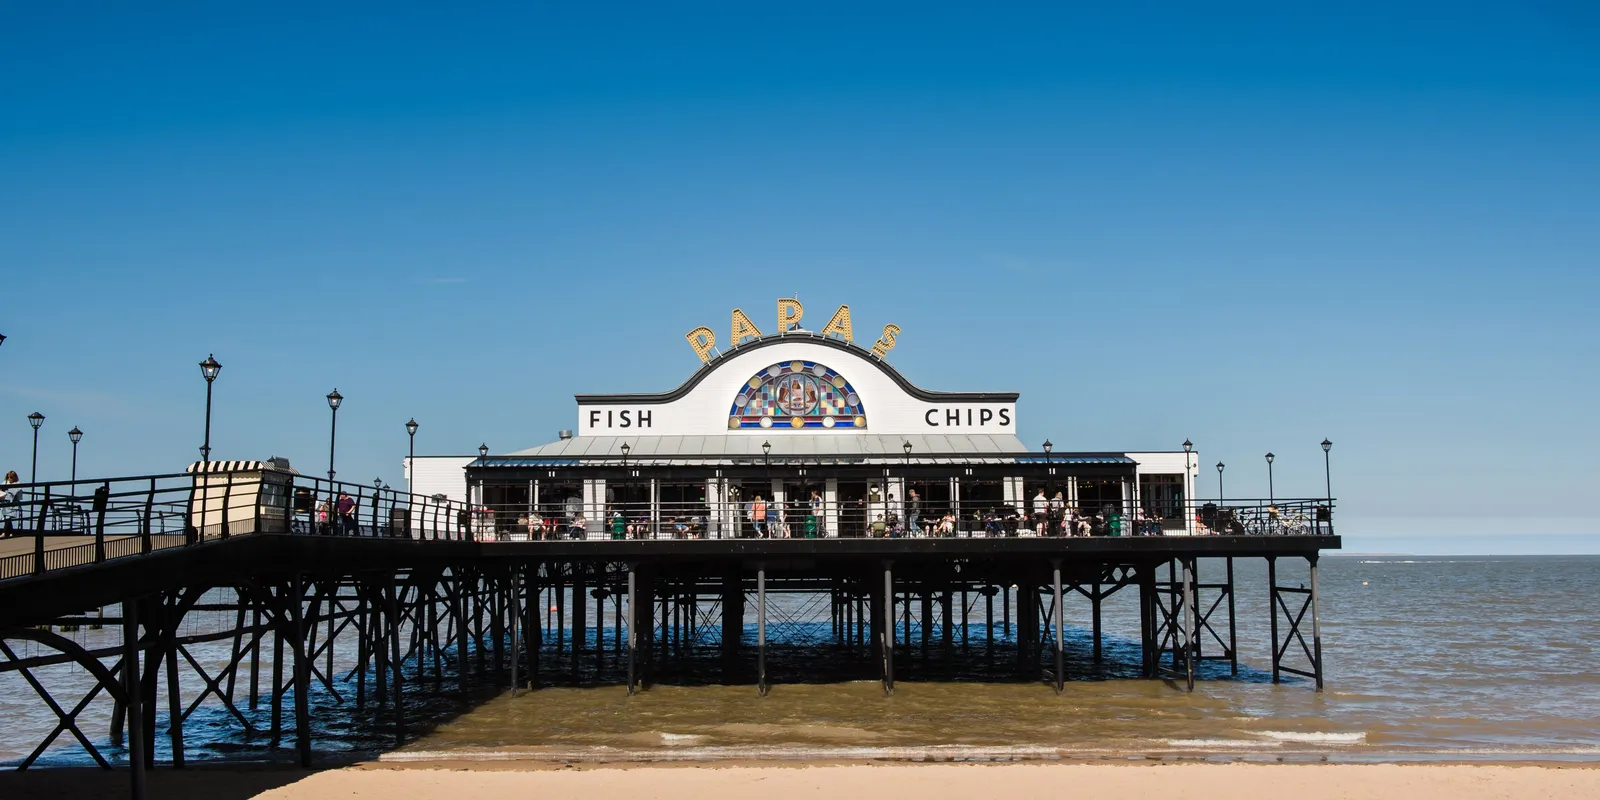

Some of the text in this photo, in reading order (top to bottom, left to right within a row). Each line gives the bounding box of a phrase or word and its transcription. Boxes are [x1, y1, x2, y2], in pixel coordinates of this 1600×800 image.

[685, 298, 902, 363] PAPAS
[589, 408, 1011, 428] FISH CHIPS
